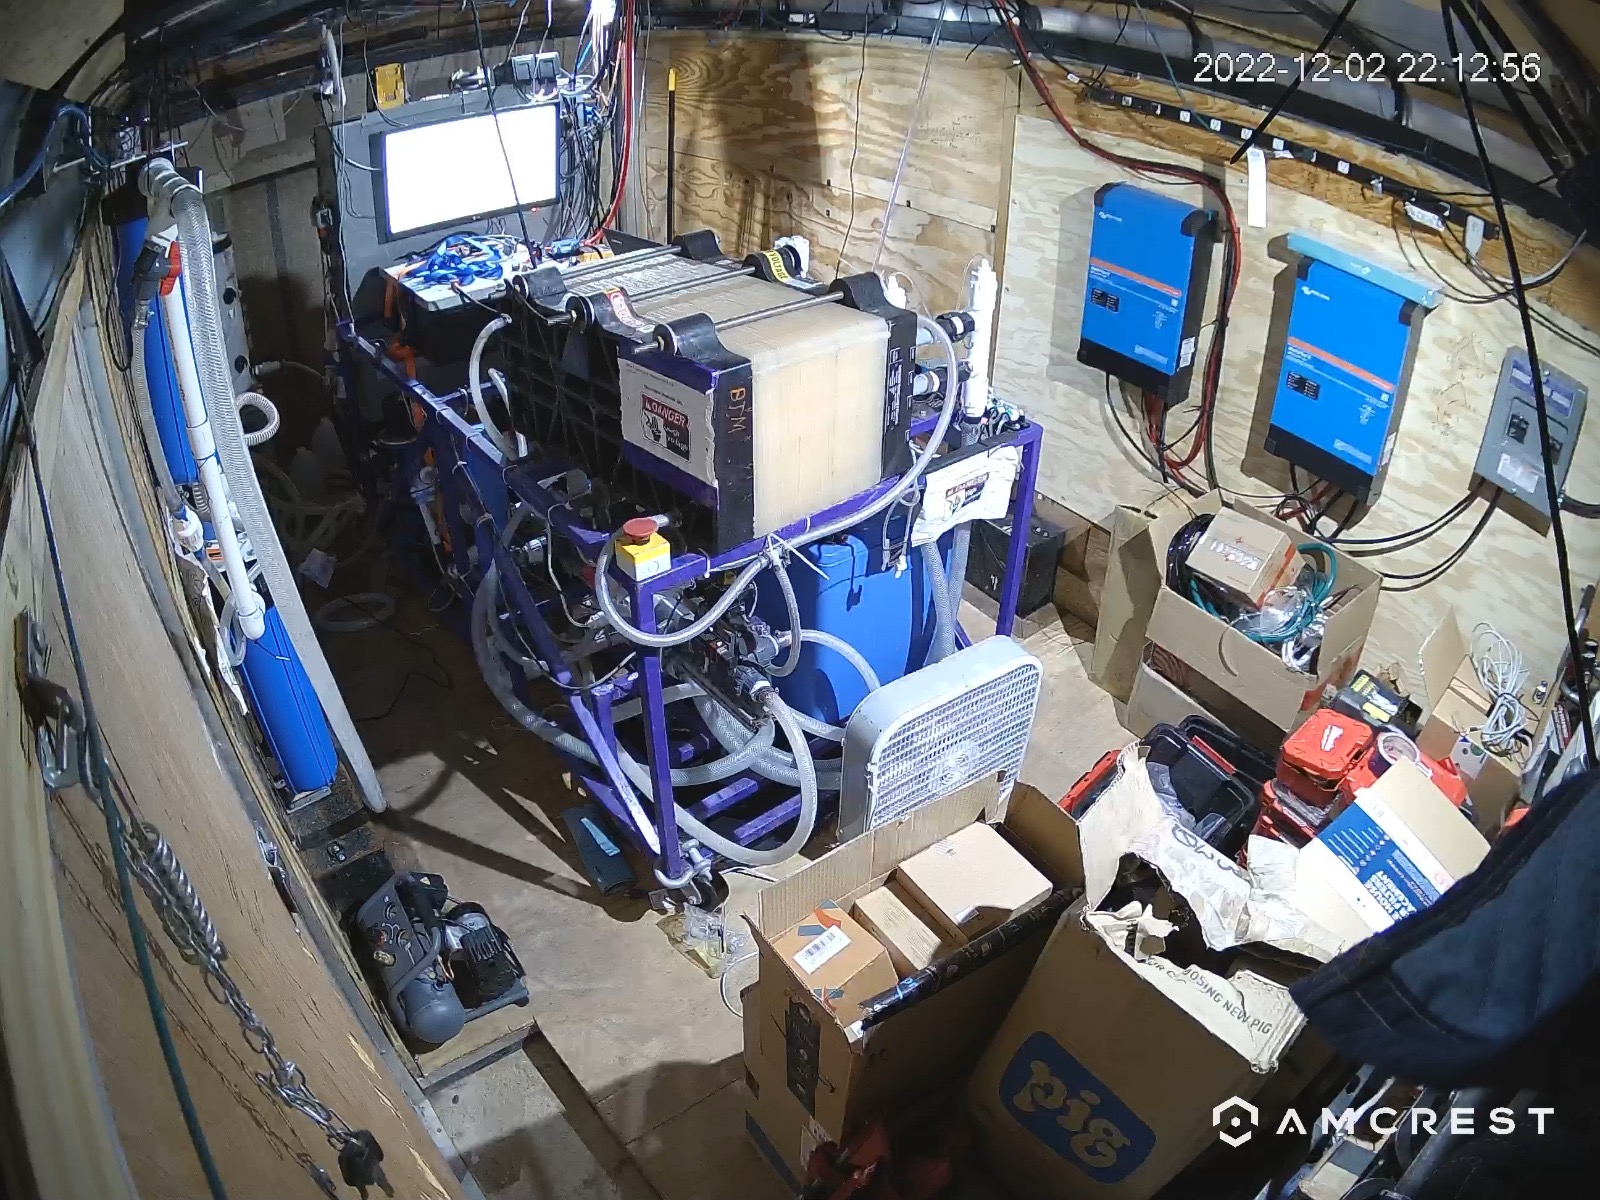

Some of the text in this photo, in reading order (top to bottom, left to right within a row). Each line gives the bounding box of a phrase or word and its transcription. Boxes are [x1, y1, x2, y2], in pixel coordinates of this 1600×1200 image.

[651, 401, 686, 428] DANGER
[1222, 999, 1250, 1024] NEW
[1250, 1017, 1273, 1035] PIG
[1012, 1059, 1131, 1168] pig
